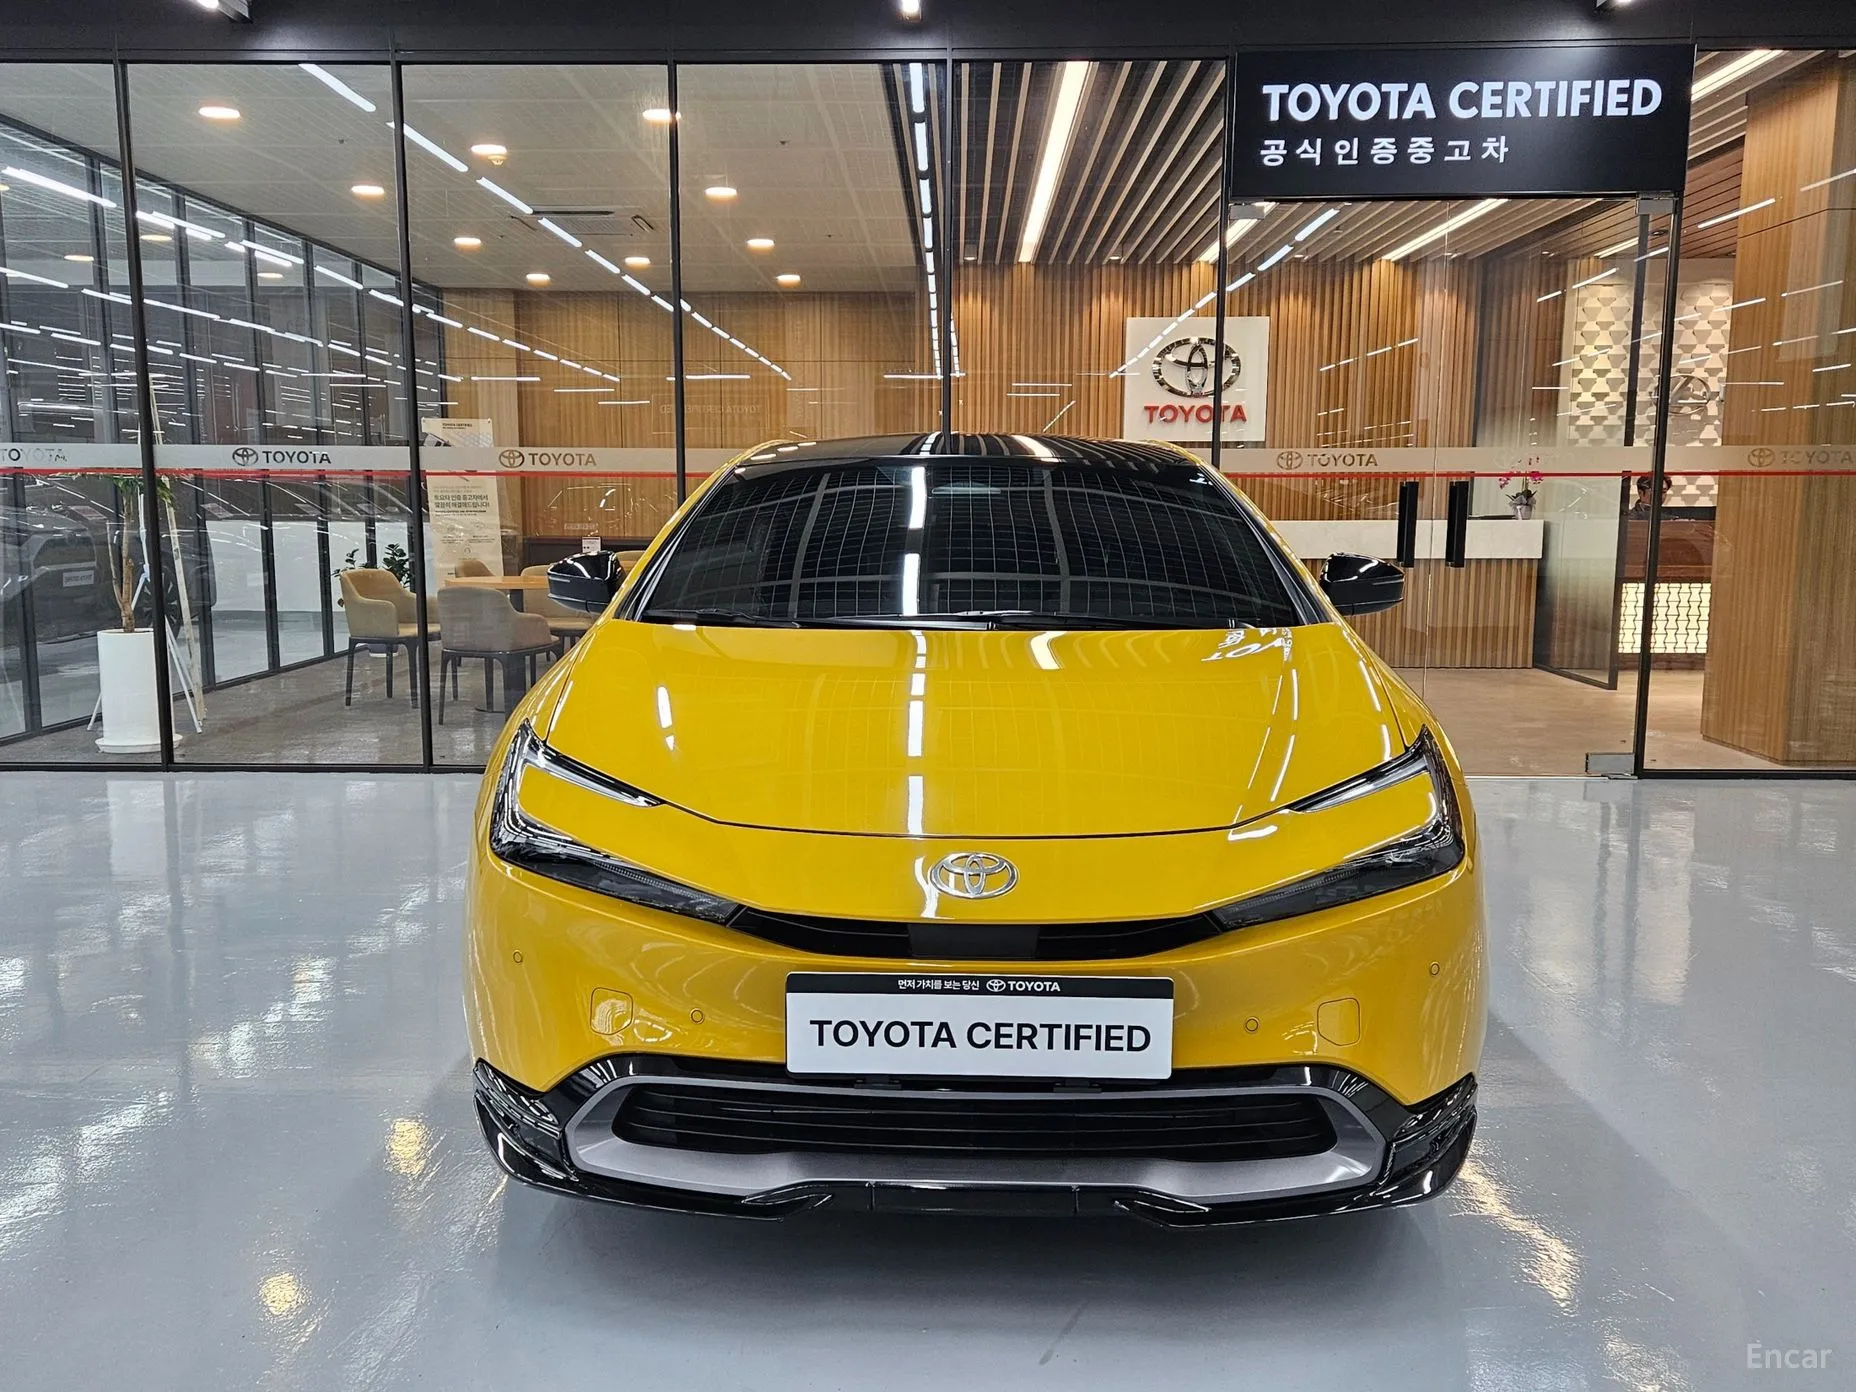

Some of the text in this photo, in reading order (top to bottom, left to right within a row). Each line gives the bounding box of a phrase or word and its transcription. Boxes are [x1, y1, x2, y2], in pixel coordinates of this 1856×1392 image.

[1262, 79, 1663, 122] TOYOTA CERTIFIED
[1143, 404, 1247, 425] TOYOTA
[262, 450, 332, 465] TOYOTA
[528, 452, 597, 467] TOYOTA
[1307, 453, 1378, 467] TOYOTA
[898, 979, 980, 991] 먼저 가치를 보는 당신
[1007, 980, 1061, 992] TOYOTA
[810, 1020, 1152, 1052] TOYOTA CERTIFIED
